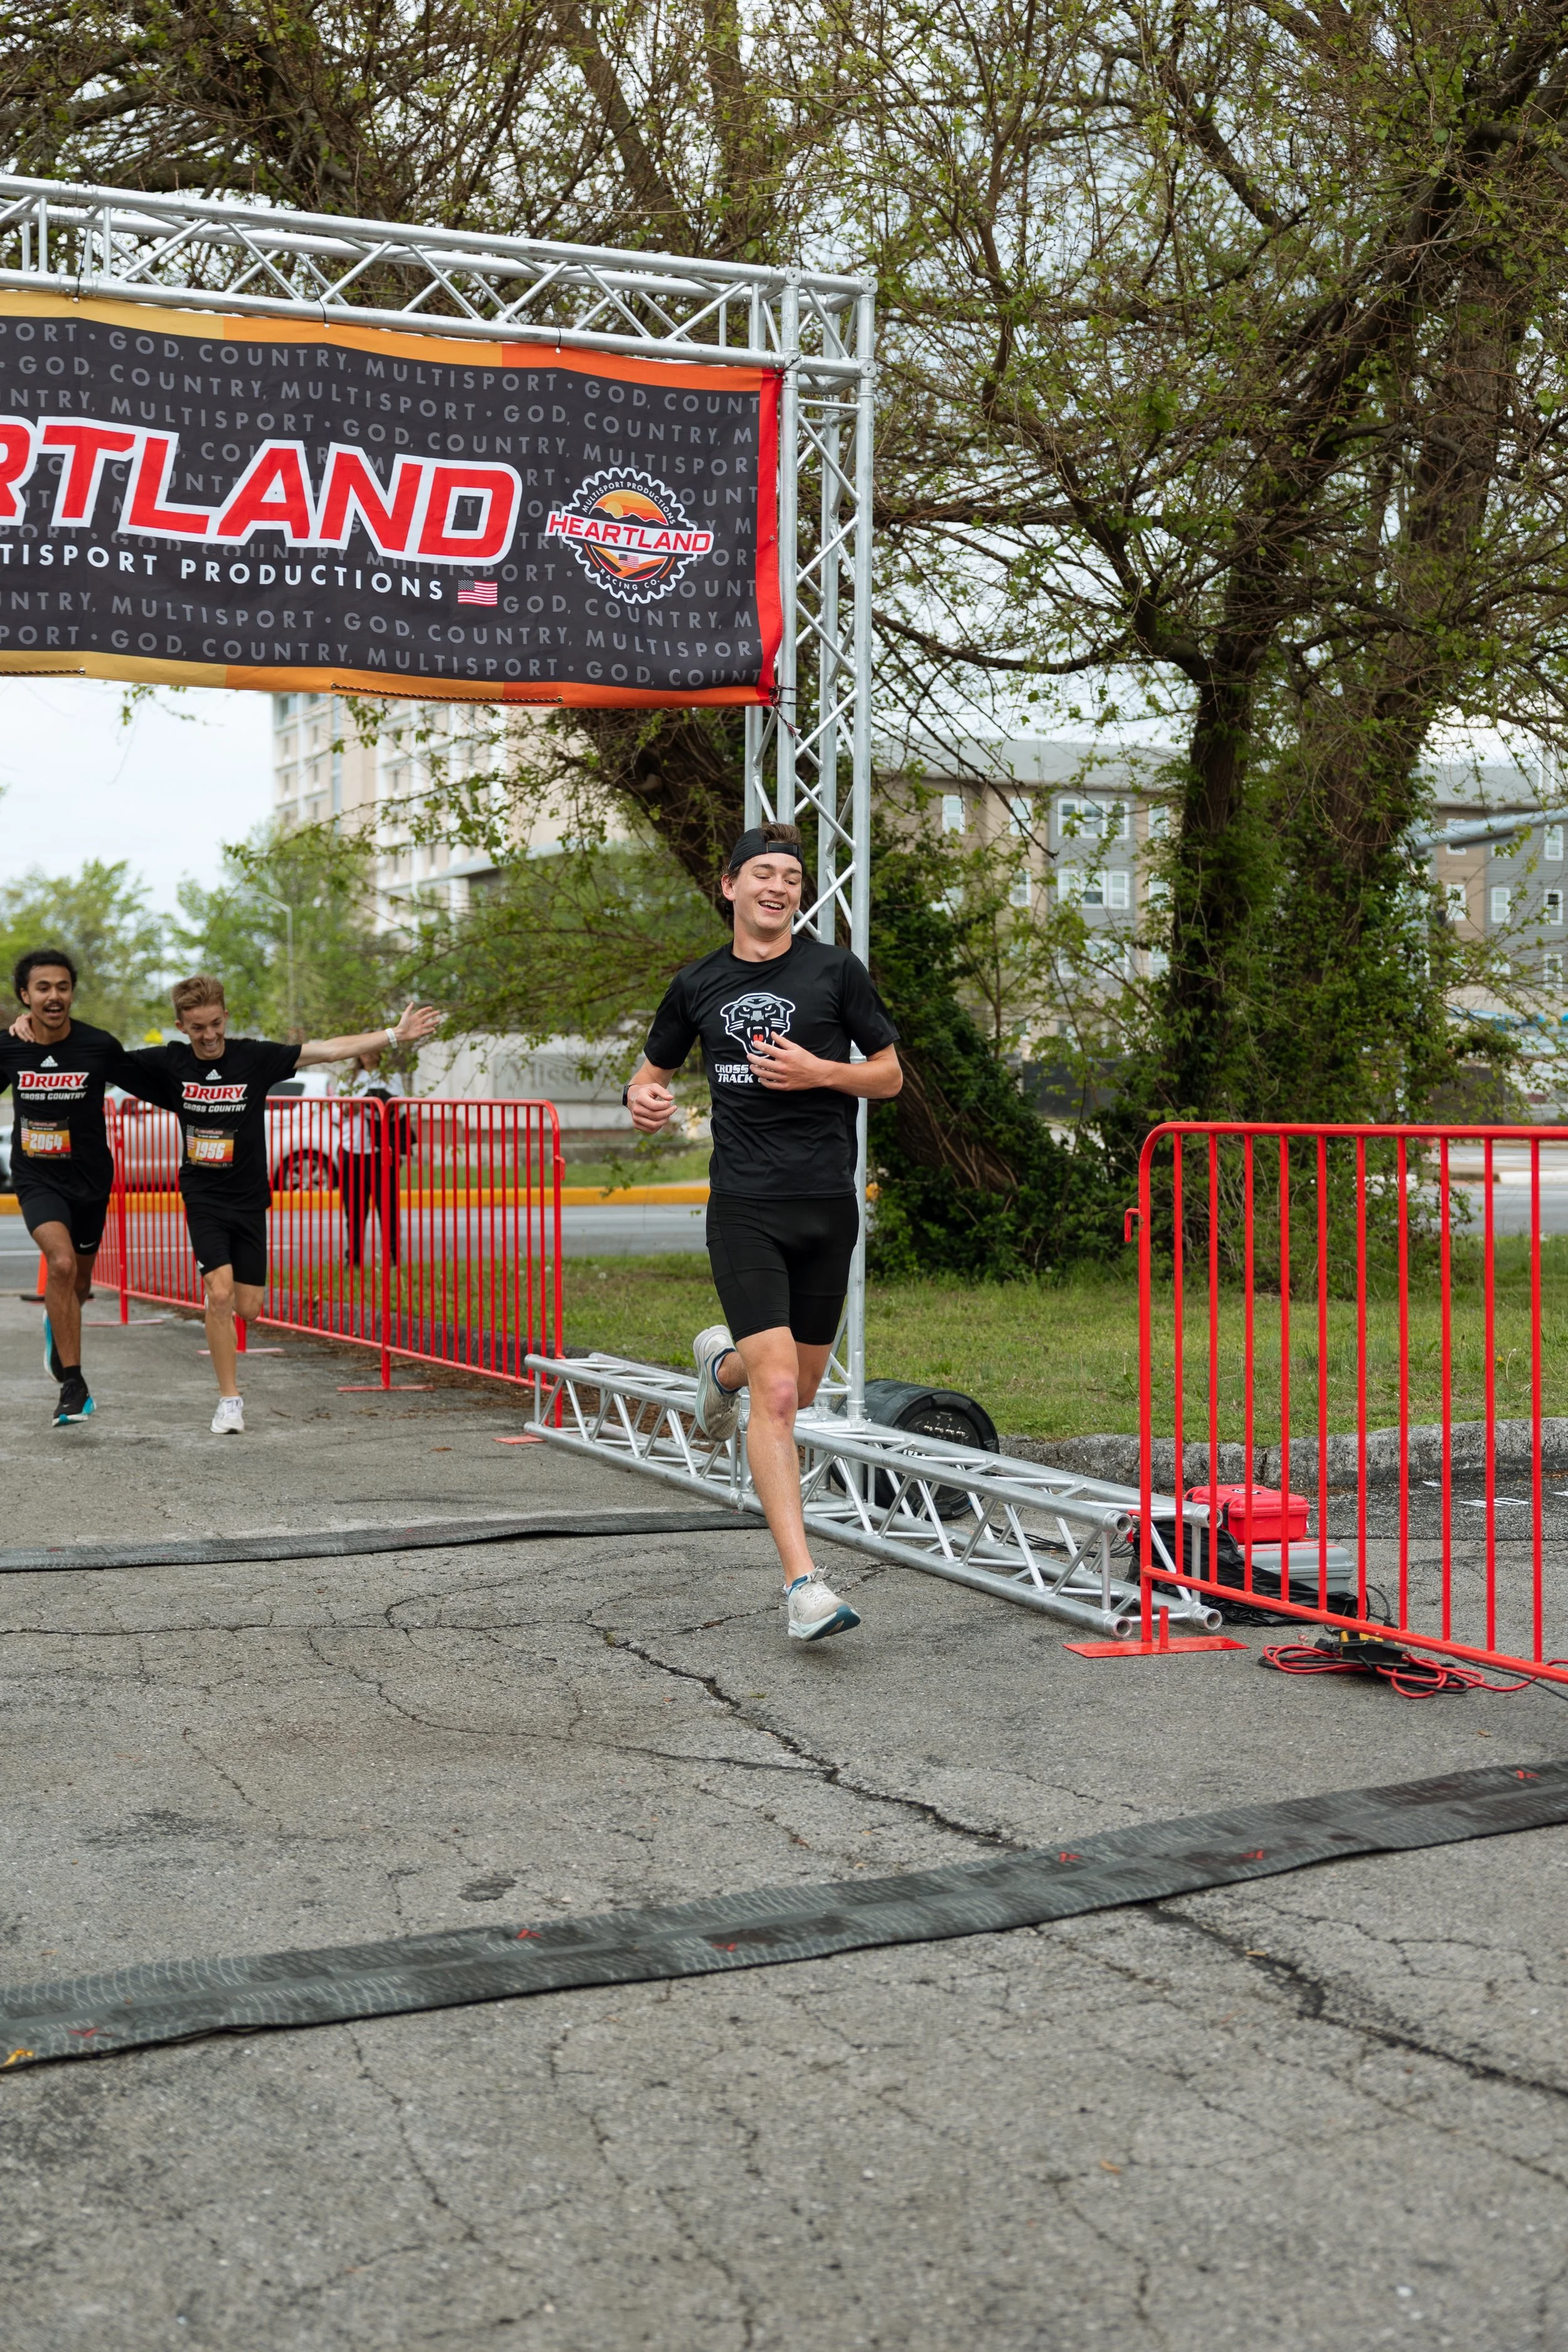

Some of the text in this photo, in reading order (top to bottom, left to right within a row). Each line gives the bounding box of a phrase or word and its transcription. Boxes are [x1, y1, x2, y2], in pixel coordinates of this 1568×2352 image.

[109, 331, 184, 361] GOD,
[199, 344, 351, 373] COUNTRY,
[366, 358, 557, 391] MULTISPORT
[585, 381, 650, 410] GOD,
[664, 393, 760, 414] COUNT
[19, 356, 95, 378] GOD,
[109, 364, 267, 400] COUNTRY,
[280, 381, 475, 421] MULTISPORT
[504, 405, 570, 426] GOD,
[584, 412, 721, 447] COUNTRY,
[110, 396, 314, 432] MULTISPORT
[342, 419, 414, 448] GOD,
[428, 432, 570, 458] COUNTRY,
[582, 481, 676, 525] MULTISPORT PRODUCTIONS
[546, 512, 713, 554] HEARTLAND
[0, 544, 443, 600] TISPORT PRODUCTIONS
[600, 568, 638, 590] RACING
[0, 591, 96, 613] NTRY,
[111, 595, 314, 628] MULTISPORT
[344, 612, 415, 640] GOD,
[428, 625, 572, 646] COUNTRY,
[503, 595, 571, 614] GOD,
[585, 598, 722, 629] COUNTRY,
[111, 629, 187, 657] GOD,
[202, 638, 352, 664] COUNTRY,
[367, 647, 557, 676] MULTISPORT
[586, 661, 655, 686] GOD,
[669, 668, 761, 686] COUNT
[17, 1071, 89, 1091] DRURY
[715, 1064, 749, 1074] CROSS
[718, 1073, 754, 1083] TRACK
[20, 1091, 87, 1101] CROSS COUNTRY
[182, 1081, 248, 1104] DRURY
[183, 1102, 246, 1113] CROSS COUNTRY
[29, 1133, 63, 1151] 2064
[195, 1140, 226, 1160] 1956
